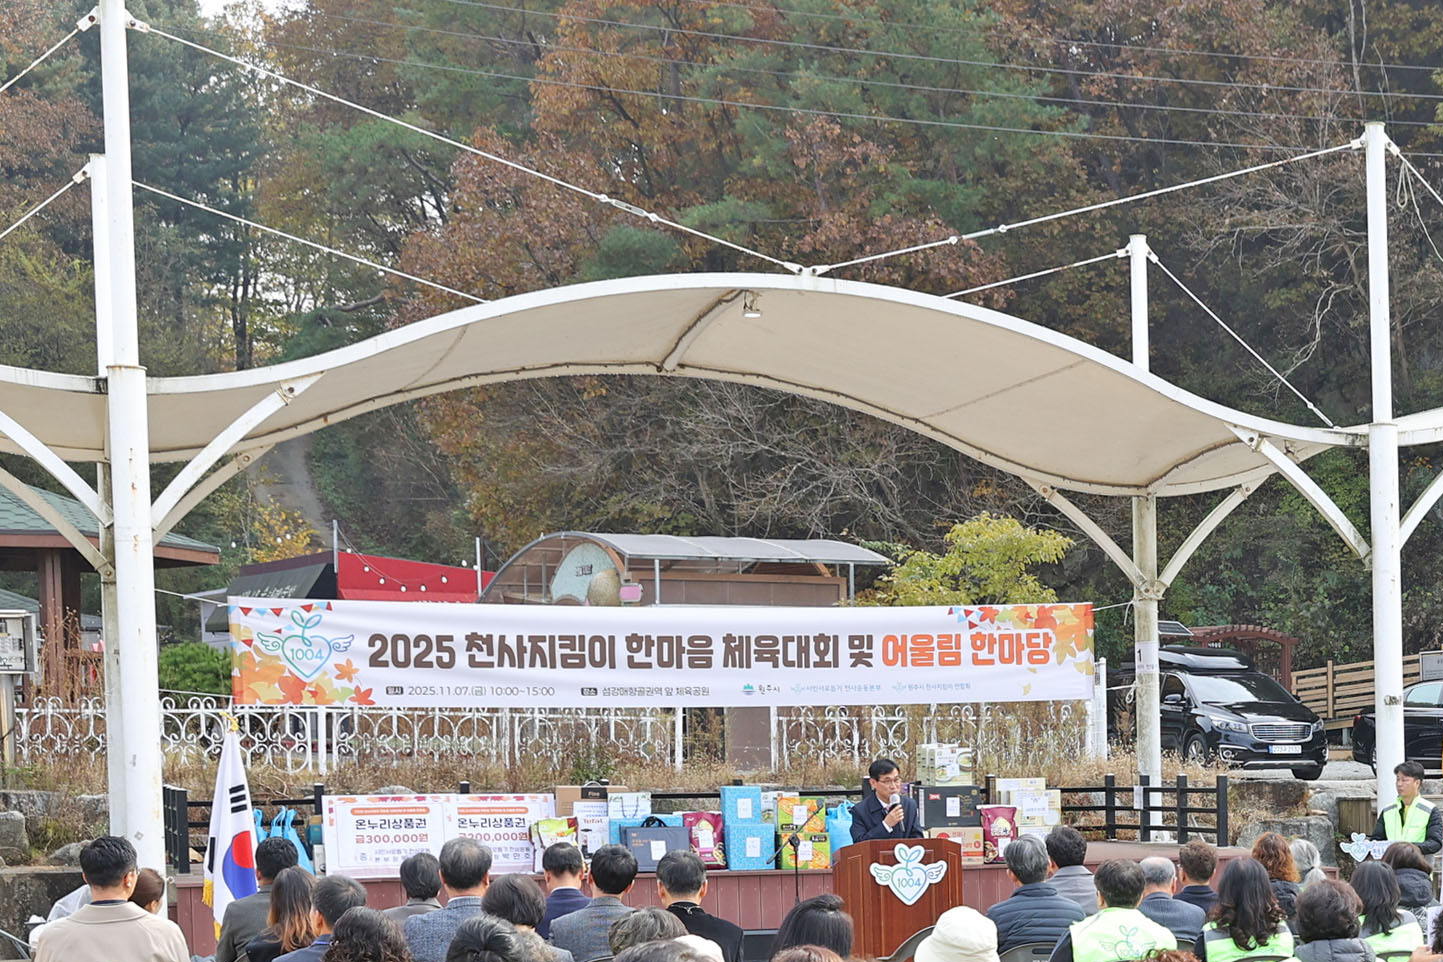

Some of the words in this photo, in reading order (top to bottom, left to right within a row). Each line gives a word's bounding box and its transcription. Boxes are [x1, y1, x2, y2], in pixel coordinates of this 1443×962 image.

[290, 648, 324, 661] 1004
[367, 633, 456, 669] 2025
[464, 632, 617, 670] 천사지킴이
[624, 632, 714, 670] 한마음
[722, 633, 840, 669] 체육대회
[848, 634, 874, 668] 및
[881, 634, 962, 667] 어울림
[970, 632, 1053, 666] 한마당
[408, 686, 487, 697] 2025.11.07.(금)
[490, 686, 555, 697] 10:00~15:00
[665, 687, 674, 697] 앞
[676, 687, 710, 697] 체육공원
[758, 684, 781, 695] 원주시
[355, 818, 427, 830] 온누리상품권
[457, 817, 526, 829] 온누리상품권
[355, 833, 428, 844] 금300,000원
[897, 877, 921, 888] 1004
